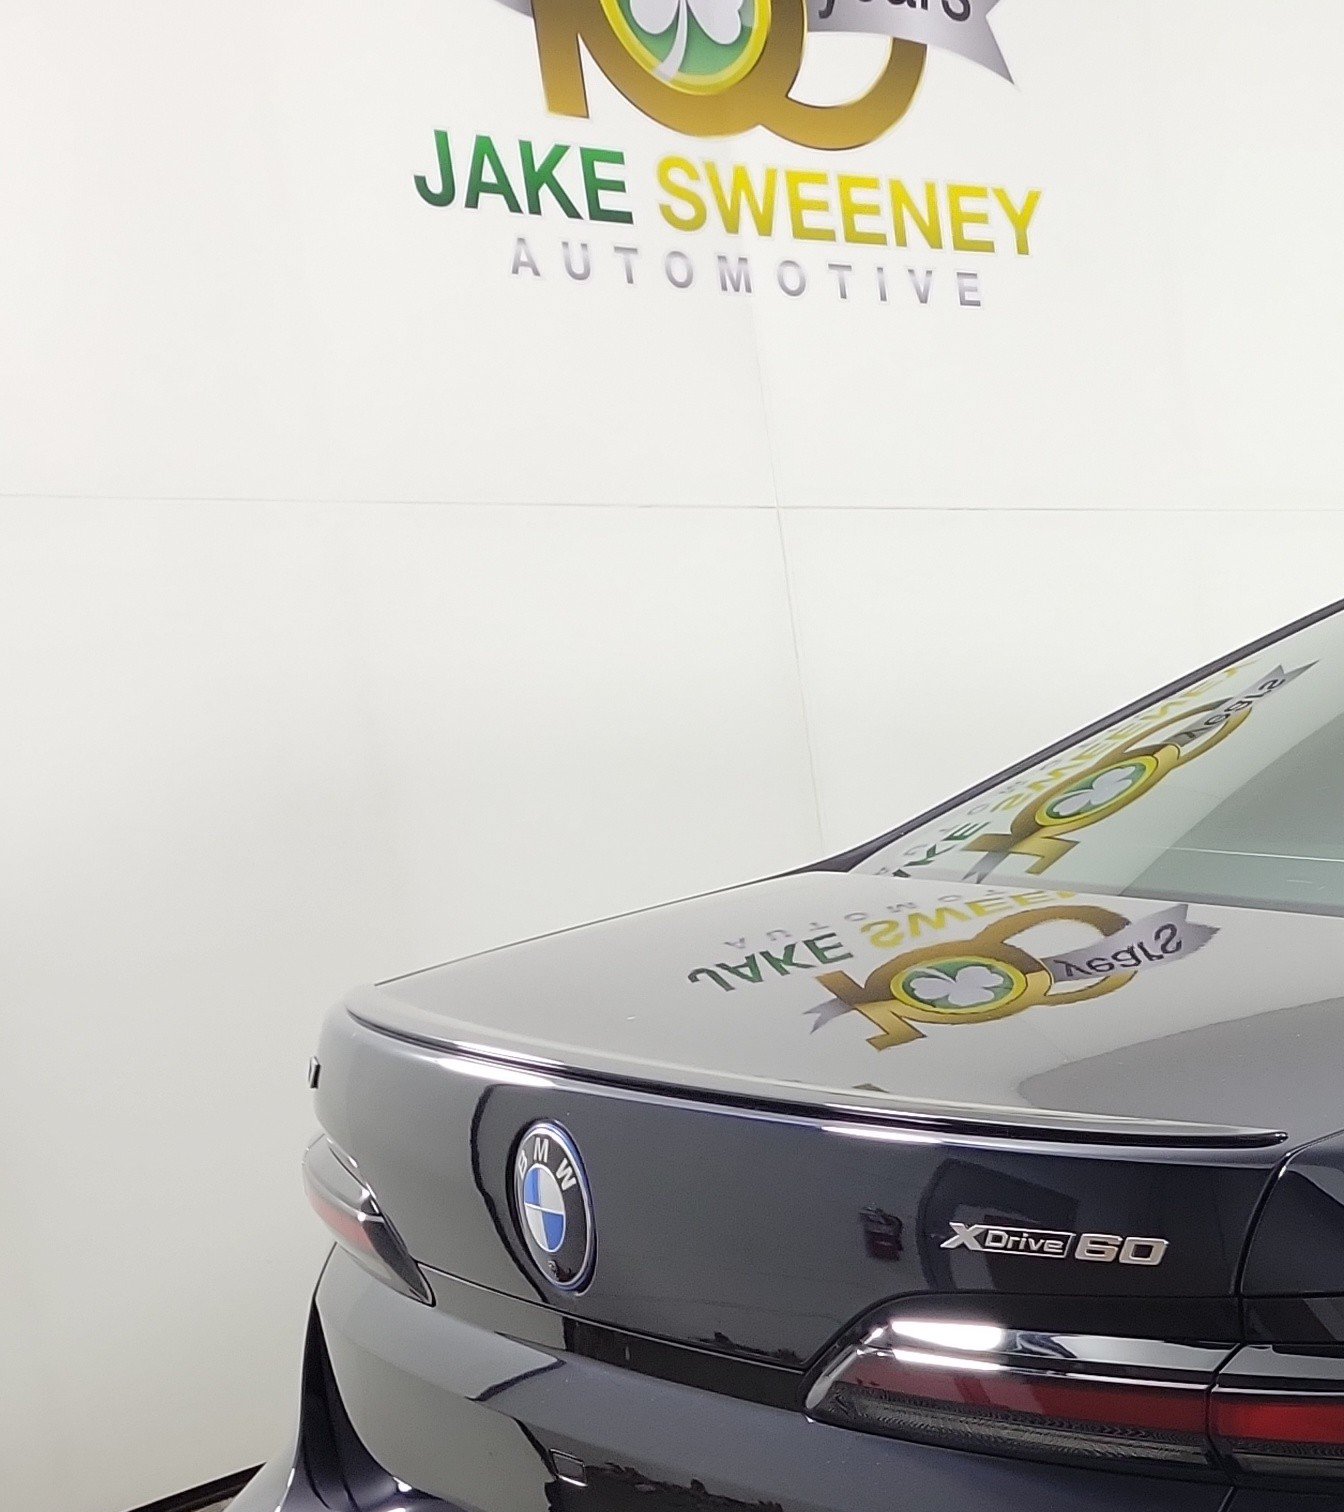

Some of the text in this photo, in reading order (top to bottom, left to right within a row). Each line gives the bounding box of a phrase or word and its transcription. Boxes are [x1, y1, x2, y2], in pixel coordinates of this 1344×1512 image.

[413, 129, 1043, 256] JAKE SWEENEY
[510, 237, 982, 308] AUTOMOTIVE
[517, 1137, 577, 1191] BMW
